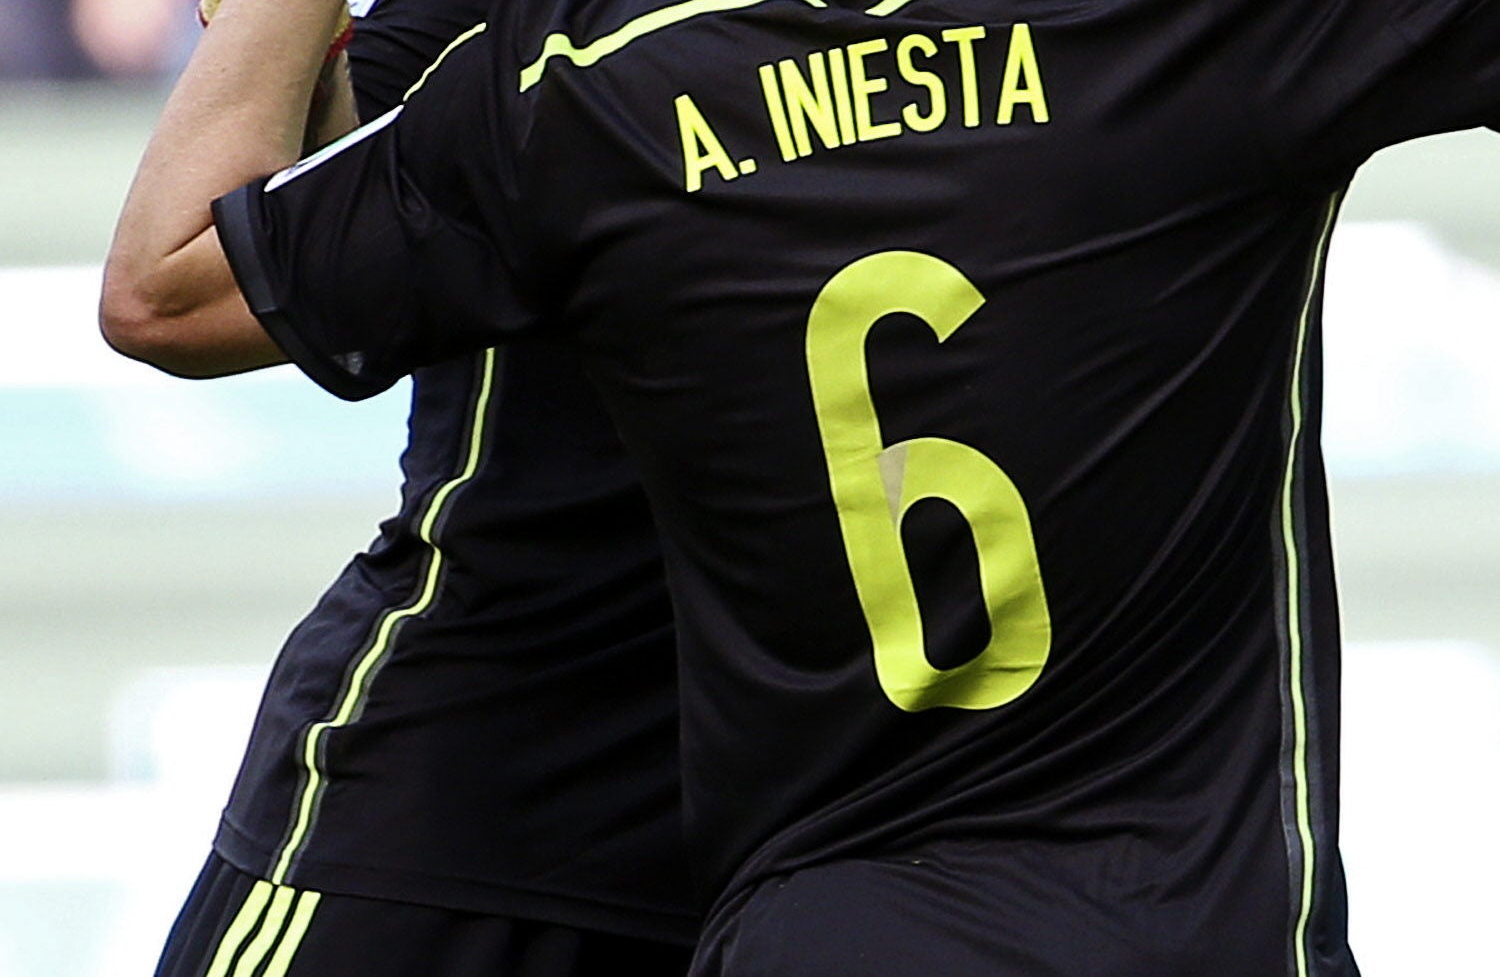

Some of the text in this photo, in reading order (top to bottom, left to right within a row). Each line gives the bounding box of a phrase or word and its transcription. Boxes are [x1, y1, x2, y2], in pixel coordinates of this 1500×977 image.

[674, 22, 1050, 193] A. INIESTA
[805, 250, 1052, 712] 6
